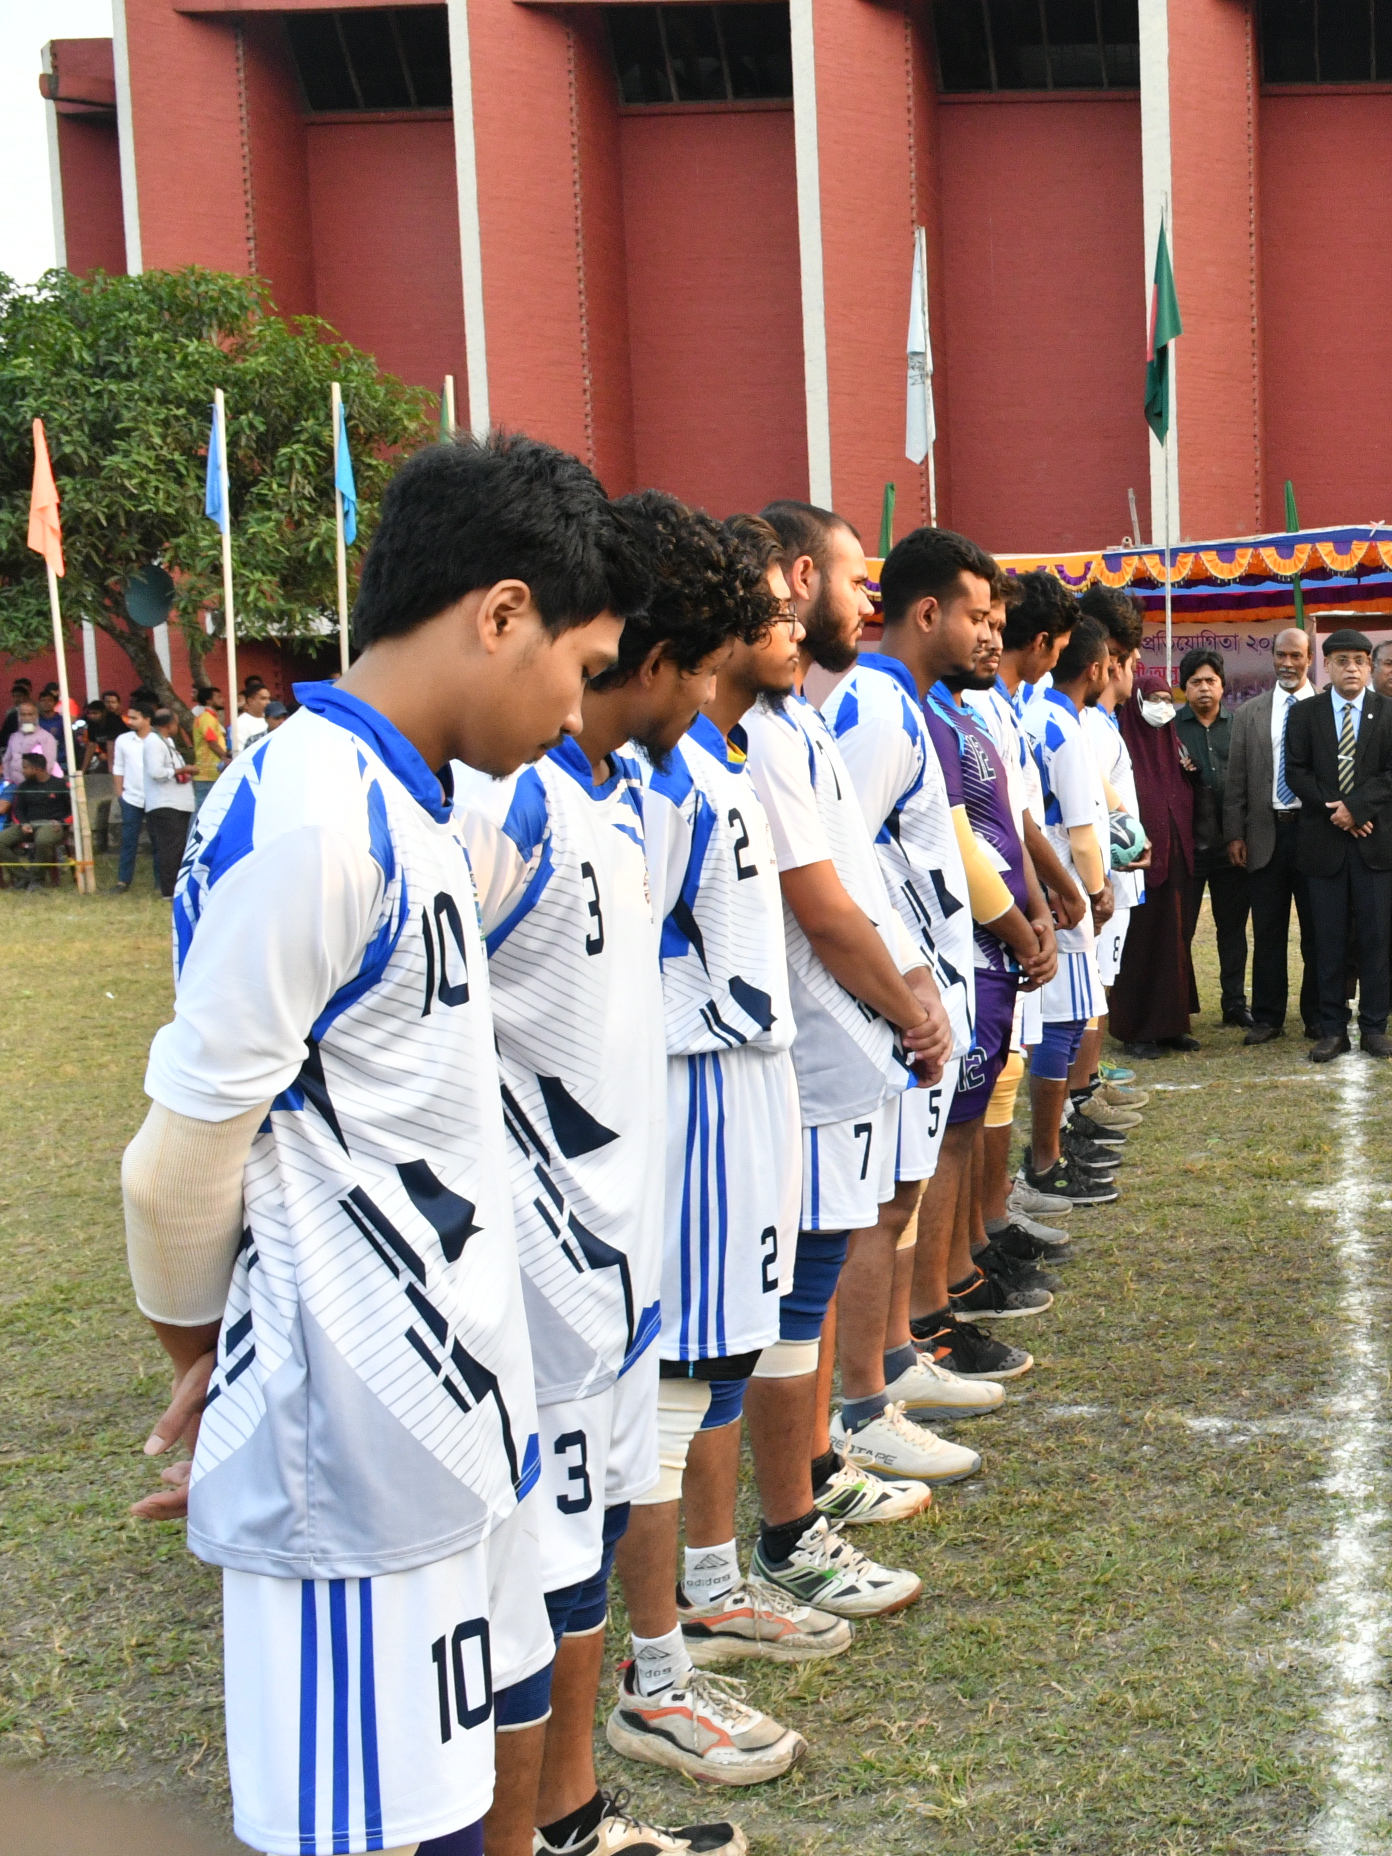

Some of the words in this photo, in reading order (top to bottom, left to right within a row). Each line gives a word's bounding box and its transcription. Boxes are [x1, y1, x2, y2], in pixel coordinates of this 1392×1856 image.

[815, 740, 842, 801] 7
[965, 734, 997, 781] 12
[728, 807, 759, 881] 2
[581, 861, 604, 956] 3
[421, 890, 470, 1018] 10
[958, 1047, 987, 1092] 12
[928, 1089, 942, 1138] 5
[854, 1122, 872, 1180] 7
[761, 1225, 779, 1294] 2
[554, 1429, 592, 1515] 3
[686, 1574, 731, 1587] adidas
[431, 1616, 493, 1744] 10
